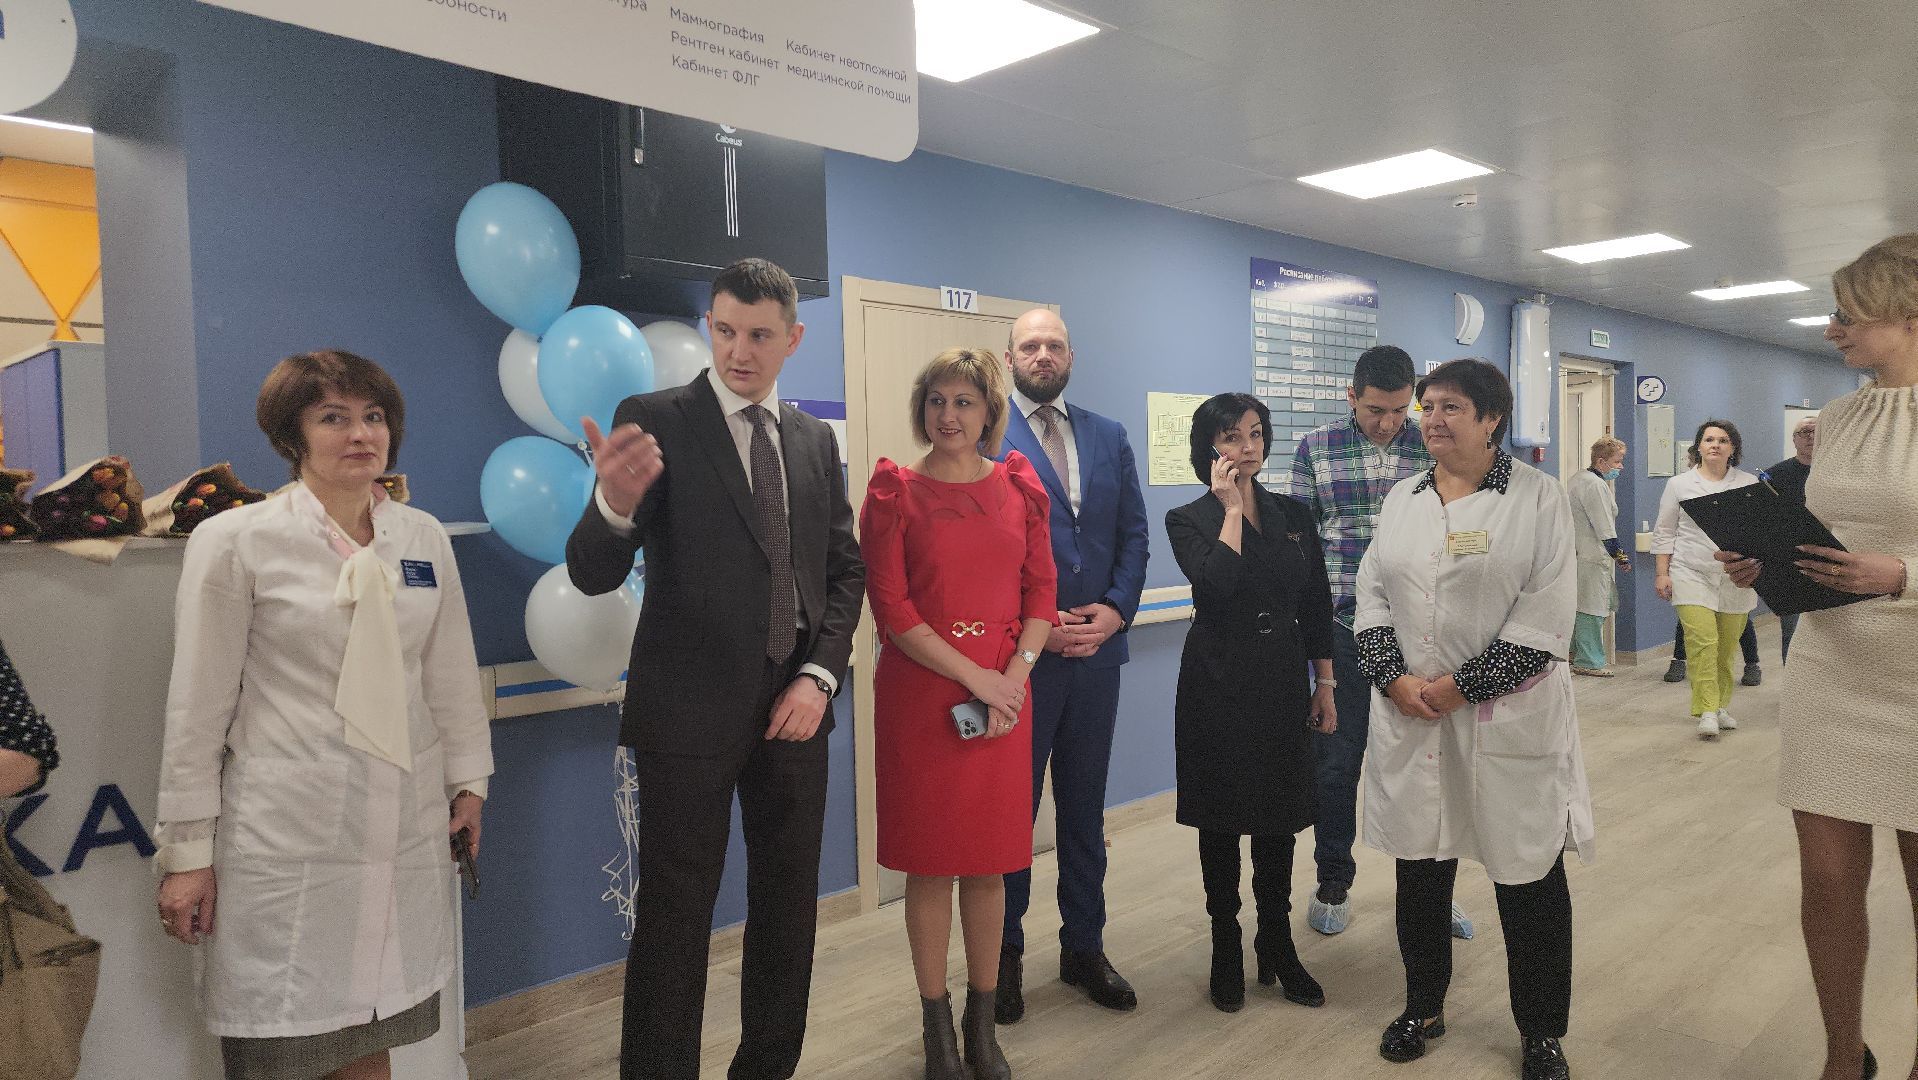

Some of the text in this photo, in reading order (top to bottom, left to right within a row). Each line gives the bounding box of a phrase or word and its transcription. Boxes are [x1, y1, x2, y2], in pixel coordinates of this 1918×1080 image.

[670, 6, 765, 44] Маммография
[671, 30, 780, 70] Рентген кабинет
[786, 39, 907, 83] Кабинет неотложной
[672, 54, 761, 87] Кабинет ФЛГ
[787, 64, 911, 104] медицинской помощи
[715, 132, 743, 147] Cabeus
[946, 289, 972, 310] 117
